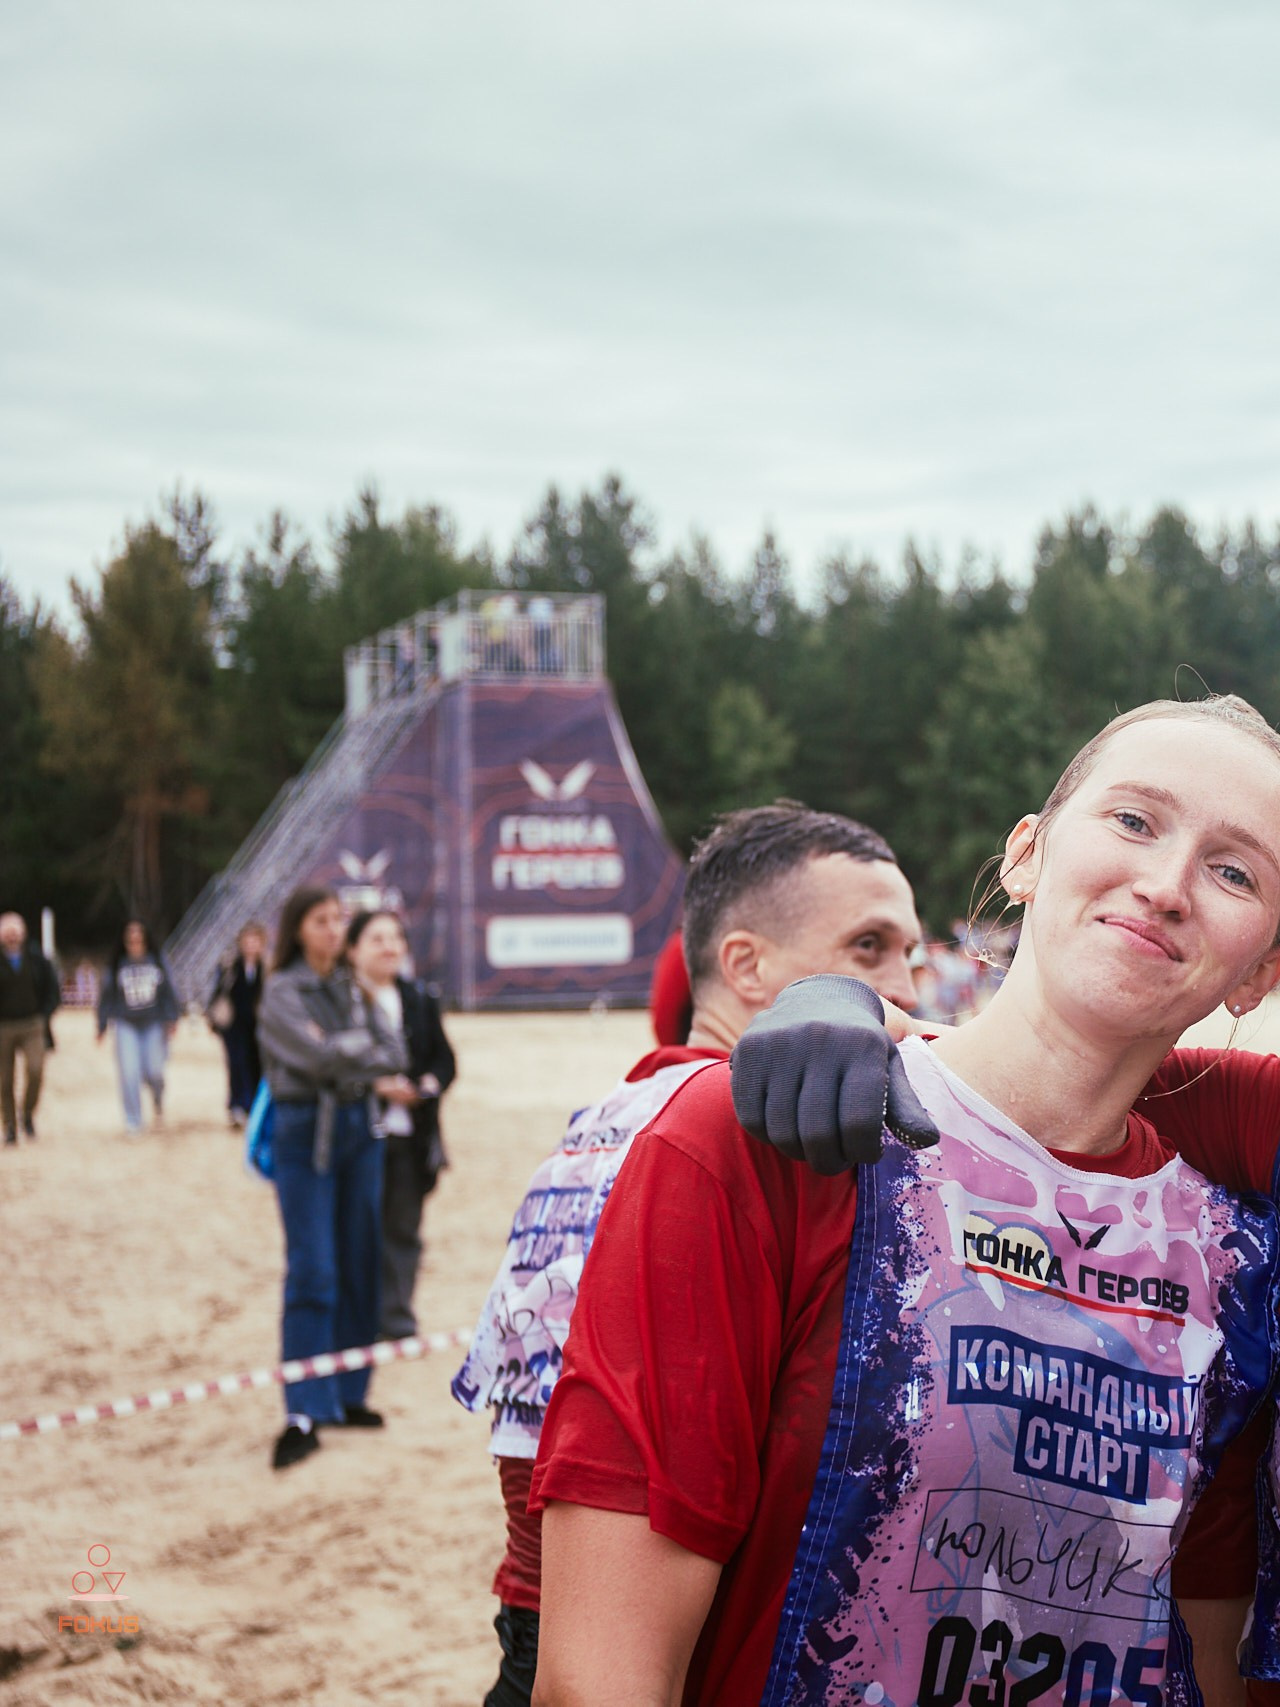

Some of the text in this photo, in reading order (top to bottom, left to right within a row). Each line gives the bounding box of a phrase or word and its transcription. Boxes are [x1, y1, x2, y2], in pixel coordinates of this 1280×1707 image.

[963, 1229, 1190, 1314] ГОНКА ГЕРОЕВ
[956, 1339, 1199, 1436] КОМАНДНЫЙ
[1024, 1416, 1142, 1495] СТАРТ
[917, 1616, 1166, 1707] 03205
